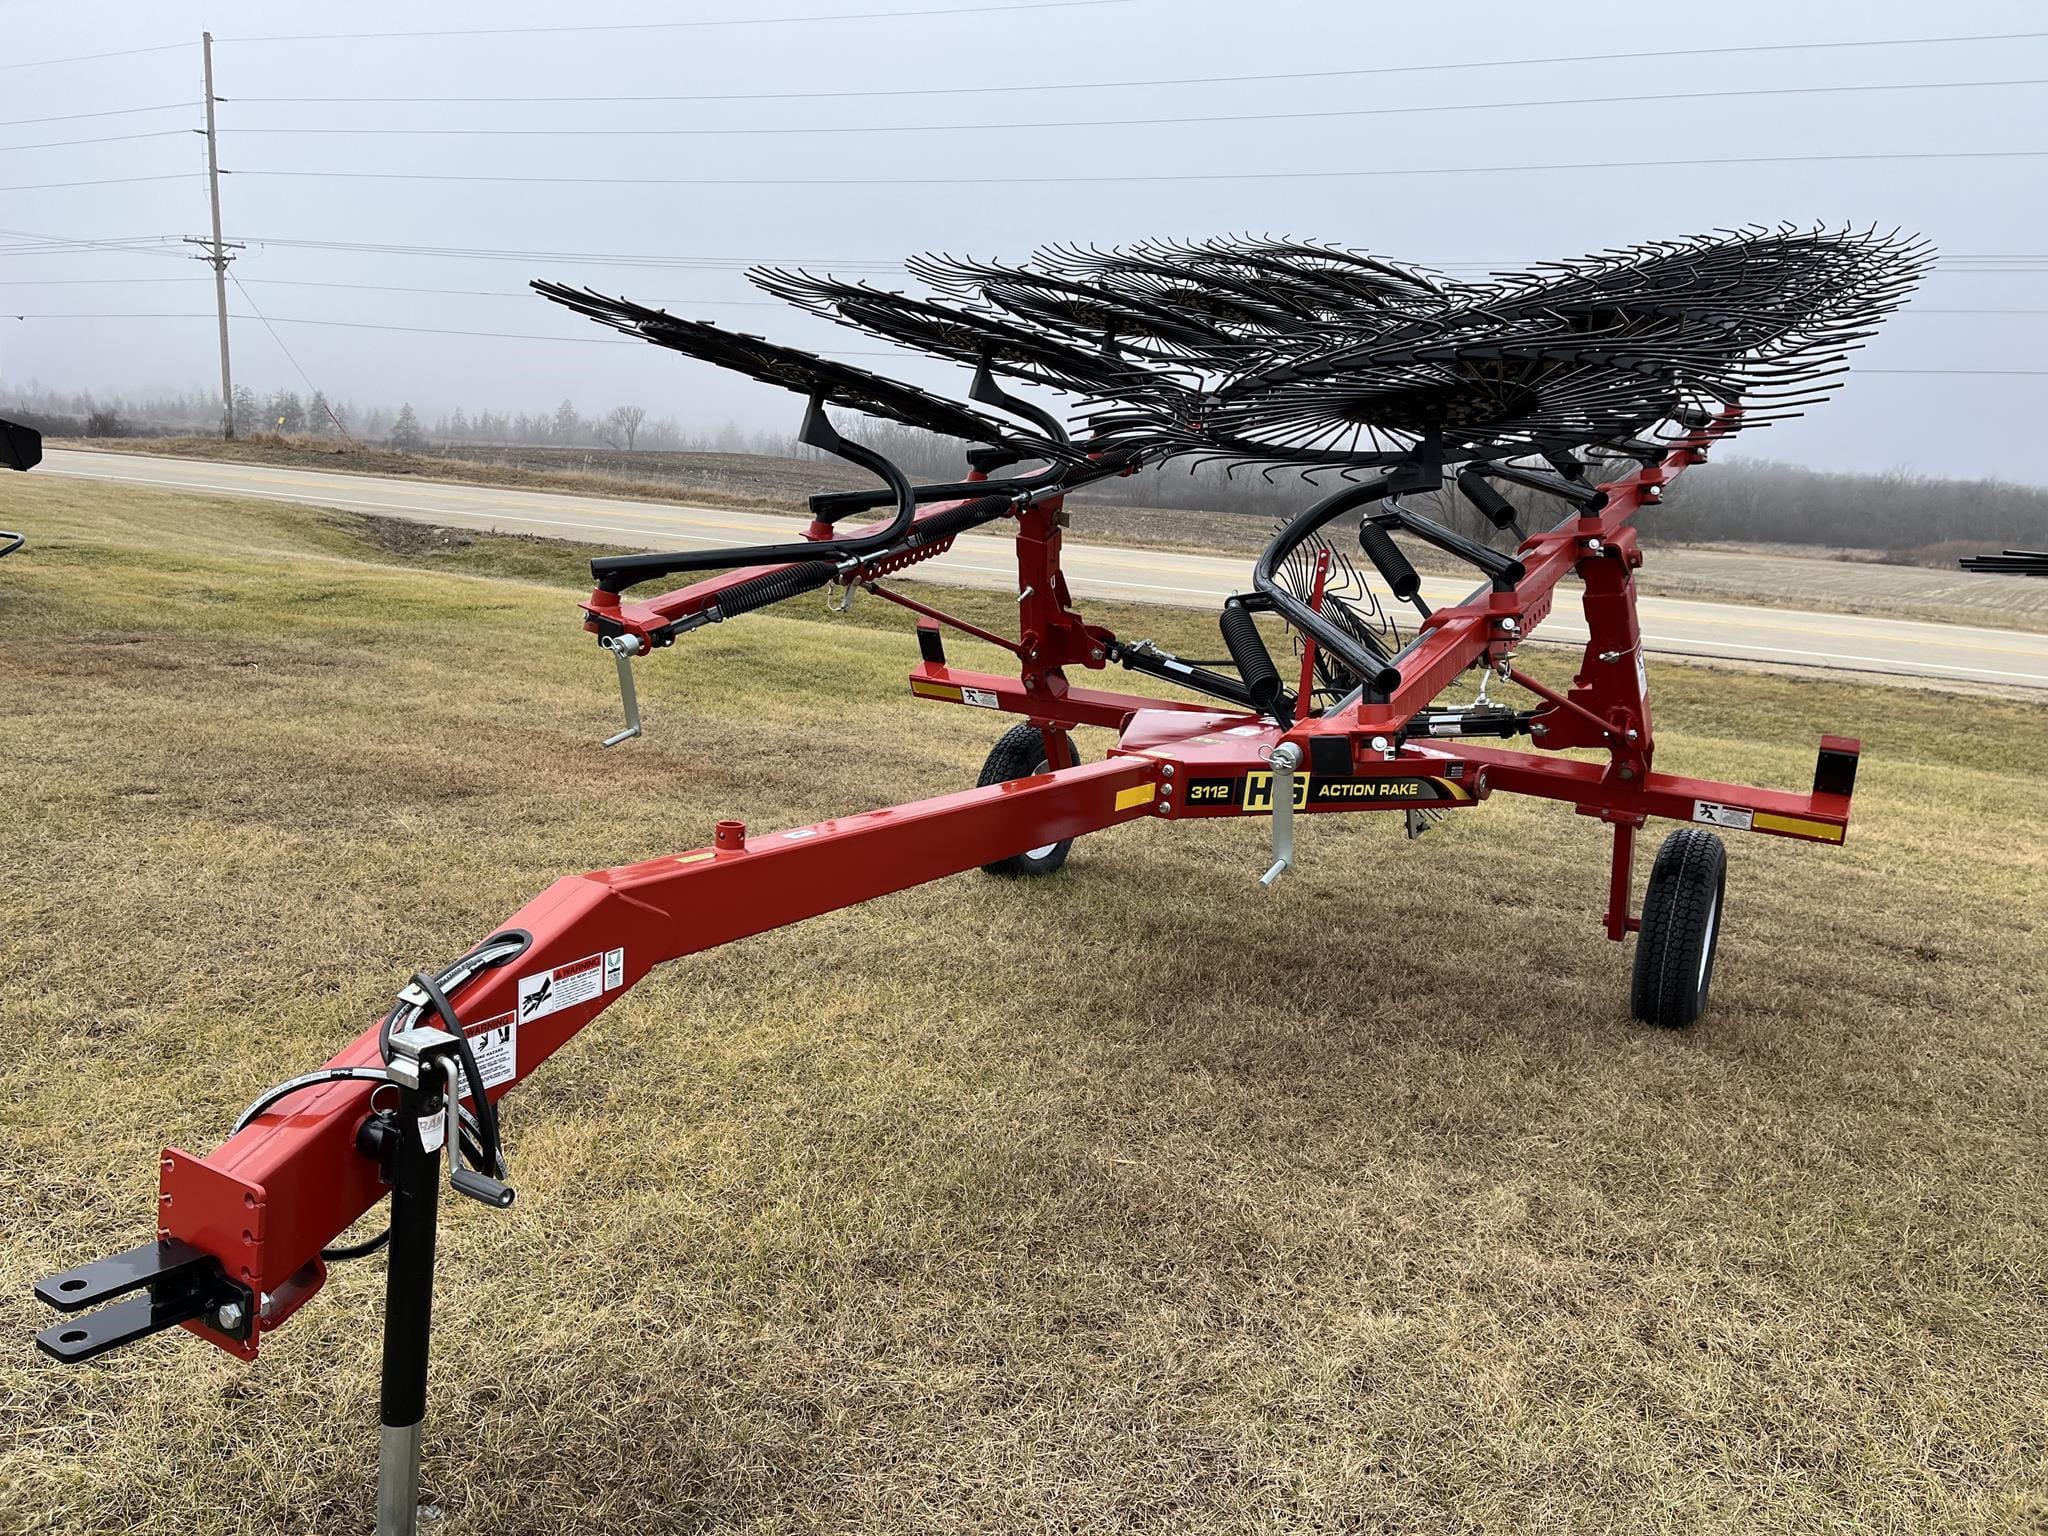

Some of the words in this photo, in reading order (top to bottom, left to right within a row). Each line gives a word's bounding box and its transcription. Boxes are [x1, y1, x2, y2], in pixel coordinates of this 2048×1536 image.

[1190, 785, 1229, 799] 3112
[1247, 776, 1306, 806] HS
[1318, 782, 1376, 797] ACTION
[1378, 782, 1419, 796] RAKE
[563, 959, 600, 976] WARNING
[466, 1016, 509, 1036] WARNING
